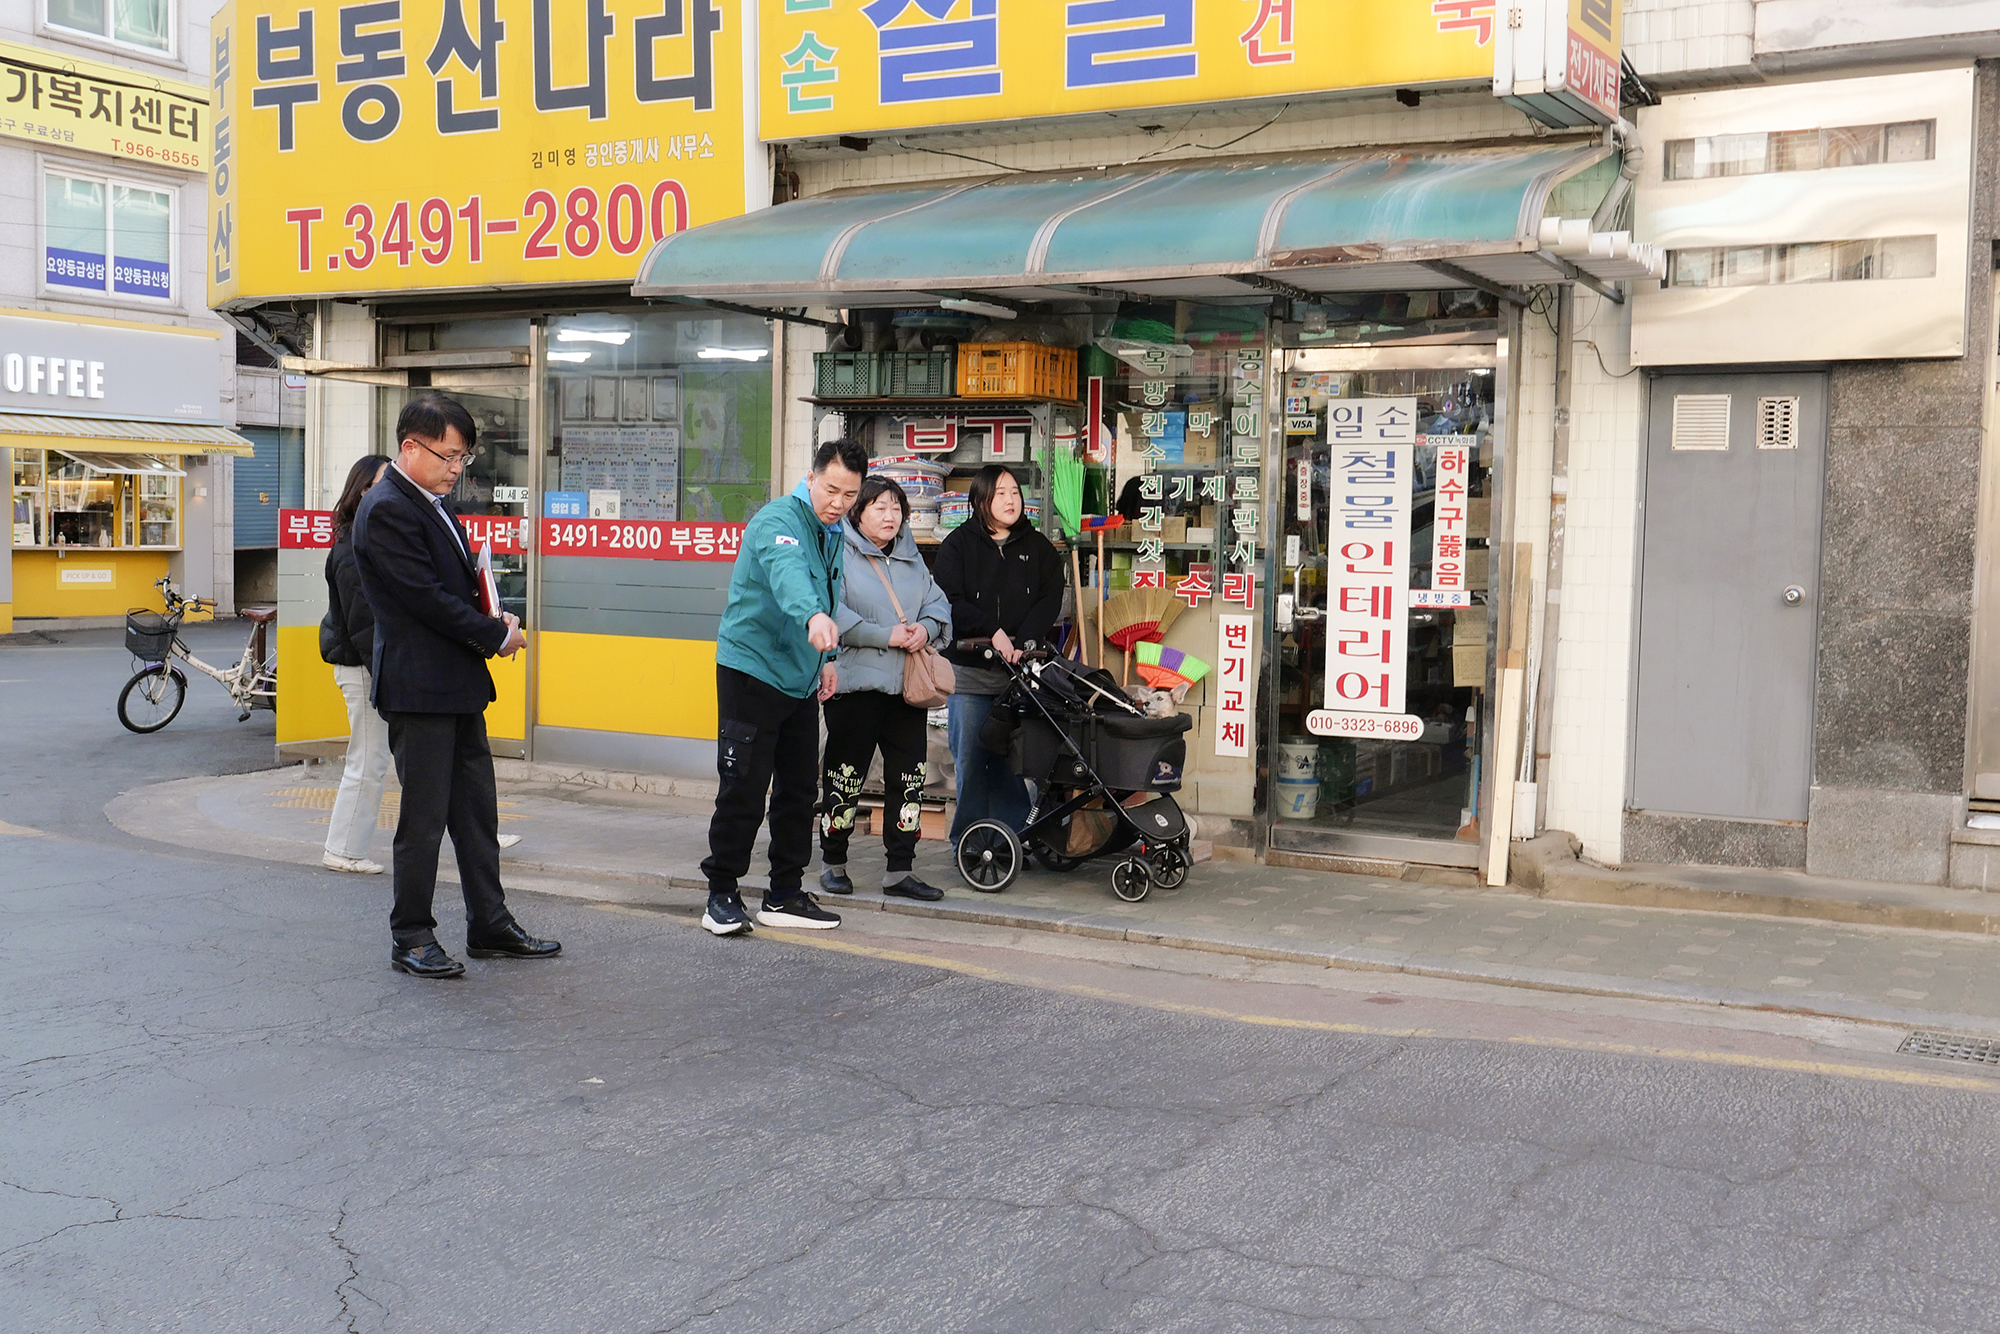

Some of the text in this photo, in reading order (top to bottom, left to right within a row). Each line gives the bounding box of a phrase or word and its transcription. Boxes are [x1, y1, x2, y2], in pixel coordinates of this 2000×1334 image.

[252, 0, 723, 152] 부동산나라
[1570, 38, 1616, 110] 전기재료
[6, 68, 199, 143] 가복지센터
[23, 122, 75, 142] 무료상담
[111, 138, 199, 168] T.956-8555
[213, 24, 233, 286] 부동산
[585, 136, 660, 168] 공인중개사
[666, 132, 714, 161] 사무소
[286, 178, 689, 273] T.3491-2800
[46, 256, 105, 280] 요양등급상담
[114, 264, 170, 289] 요양등급신청
[1291, 420, 1313, 429] VISA
[1332, 405, 1410, 439] 일손
[495, 488, 528, 501] 미세요
[550, 524, 662, 550] 3491-2800
[1221, 624, 1246, 748] 변기교체
[1310, 714, 1419, 735] 010-3323-6896
[827, 769, 849, 785] HAPPY
